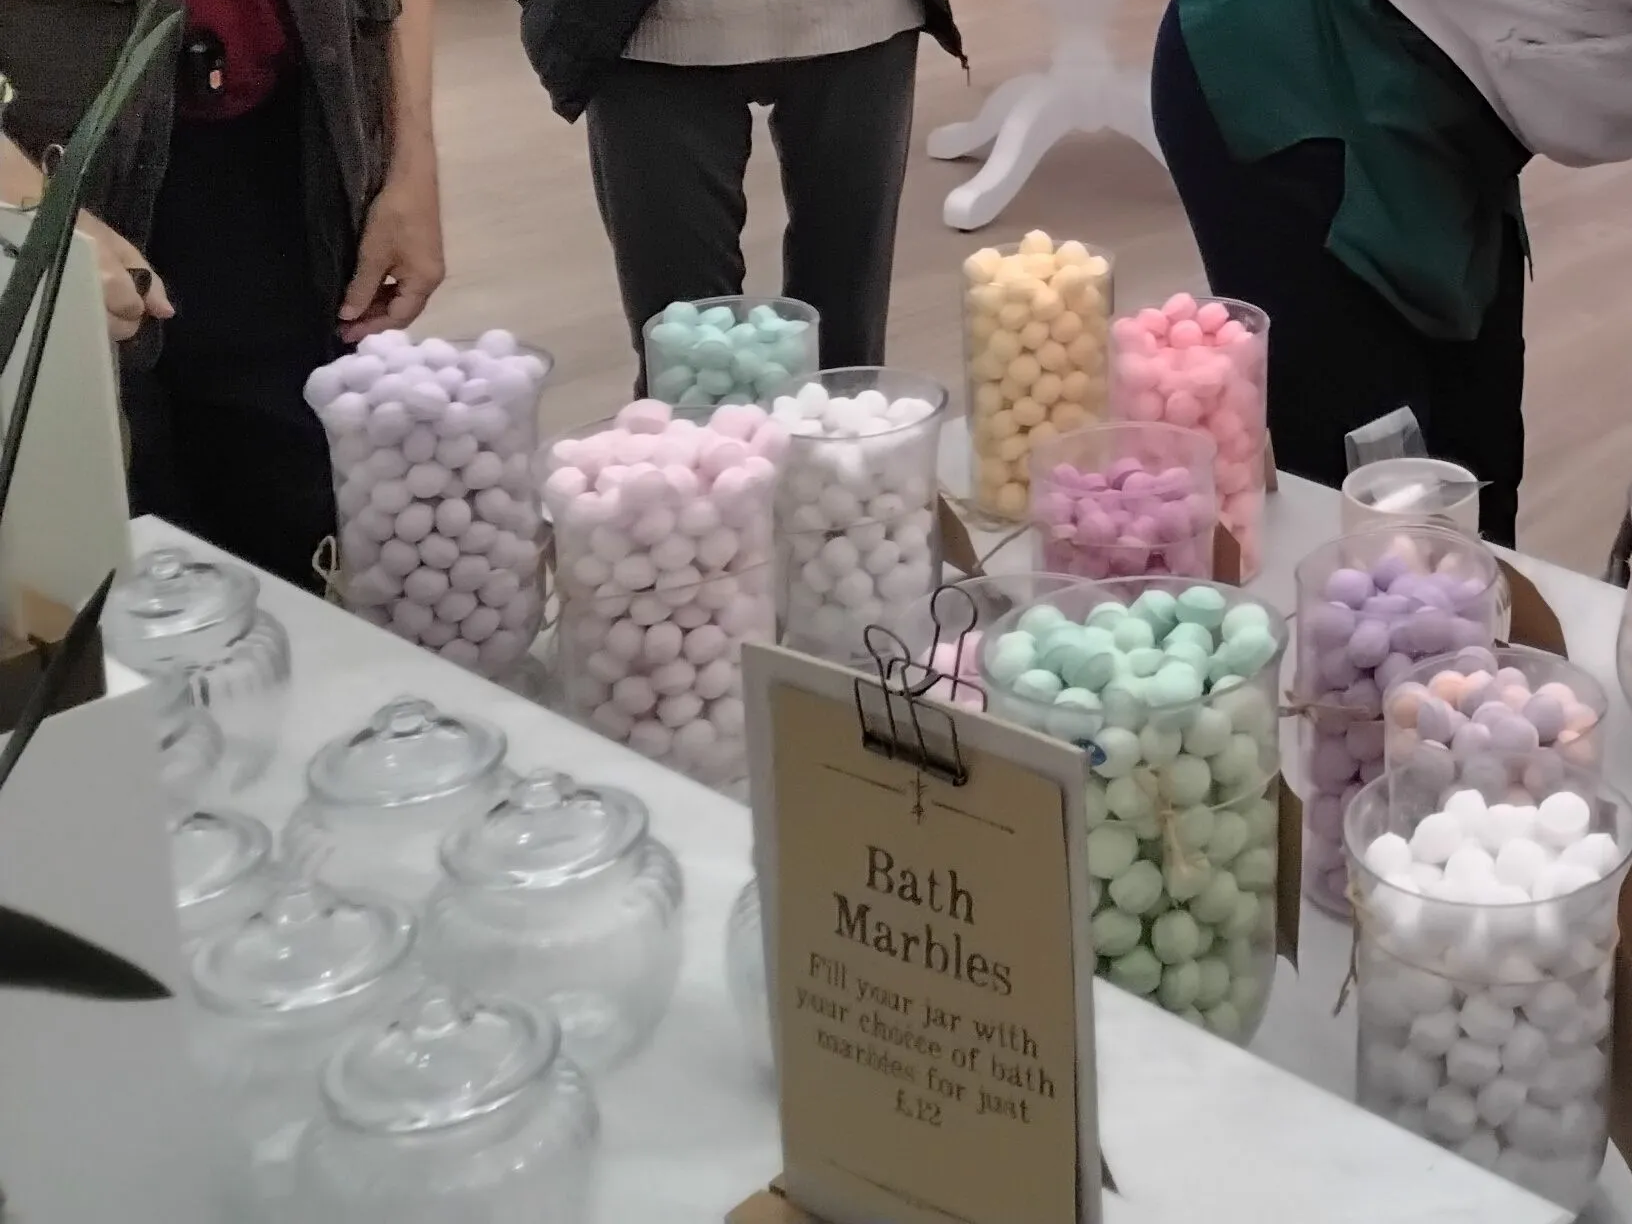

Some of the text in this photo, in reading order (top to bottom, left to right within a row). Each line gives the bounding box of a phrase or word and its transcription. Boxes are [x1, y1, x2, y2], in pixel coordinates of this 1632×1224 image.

[866, 845, 975, 925] Bath
[833, 890, 1013, 996] Marbles
[795, 986, 1056, 1099] your choice of bath
[809, 951, 1039, 1061] Fill your jar with
[817, 1029, 1031, 1124] marbles for just
[895, 1088, 943, 1127] £12
